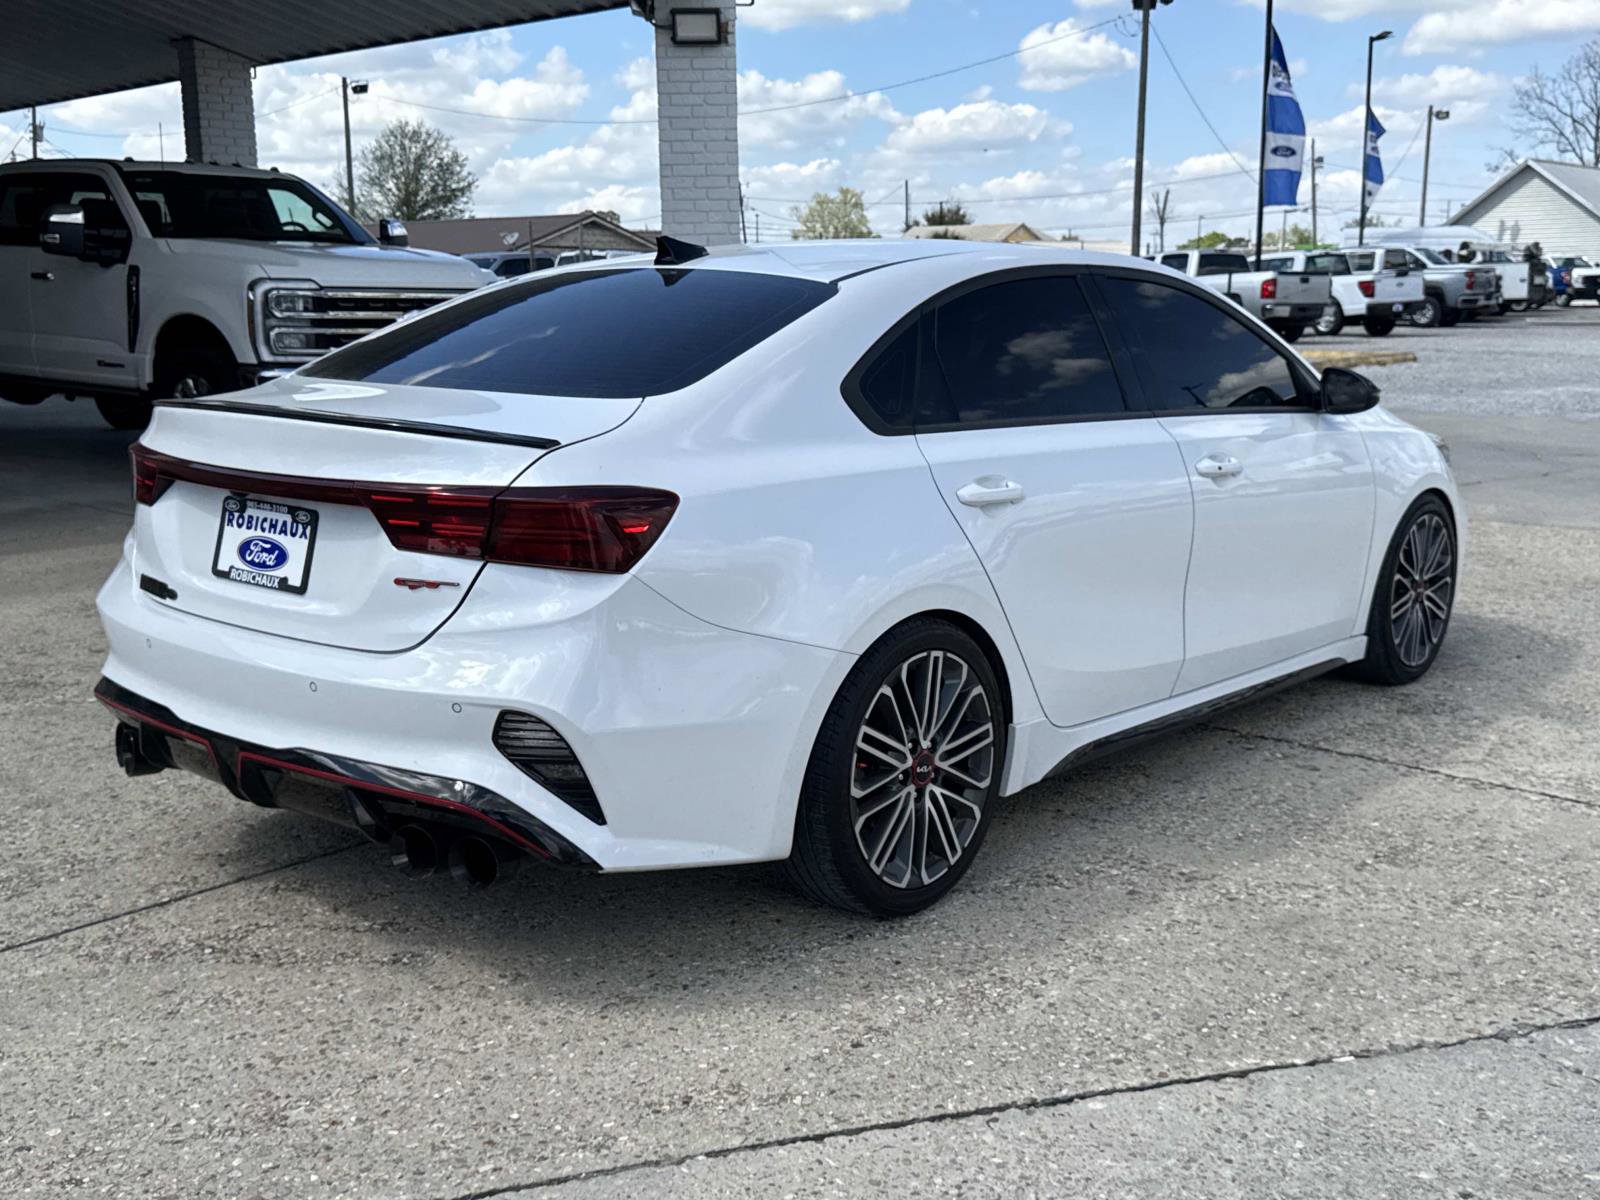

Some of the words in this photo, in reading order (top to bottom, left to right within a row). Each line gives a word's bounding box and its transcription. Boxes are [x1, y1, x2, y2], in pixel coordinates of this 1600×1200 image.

[227, 511, 310, 539] ROBICHAUX
[245, 540, 279, 566] Ford
[230, 569, 280, 588] ROBICHAUX
